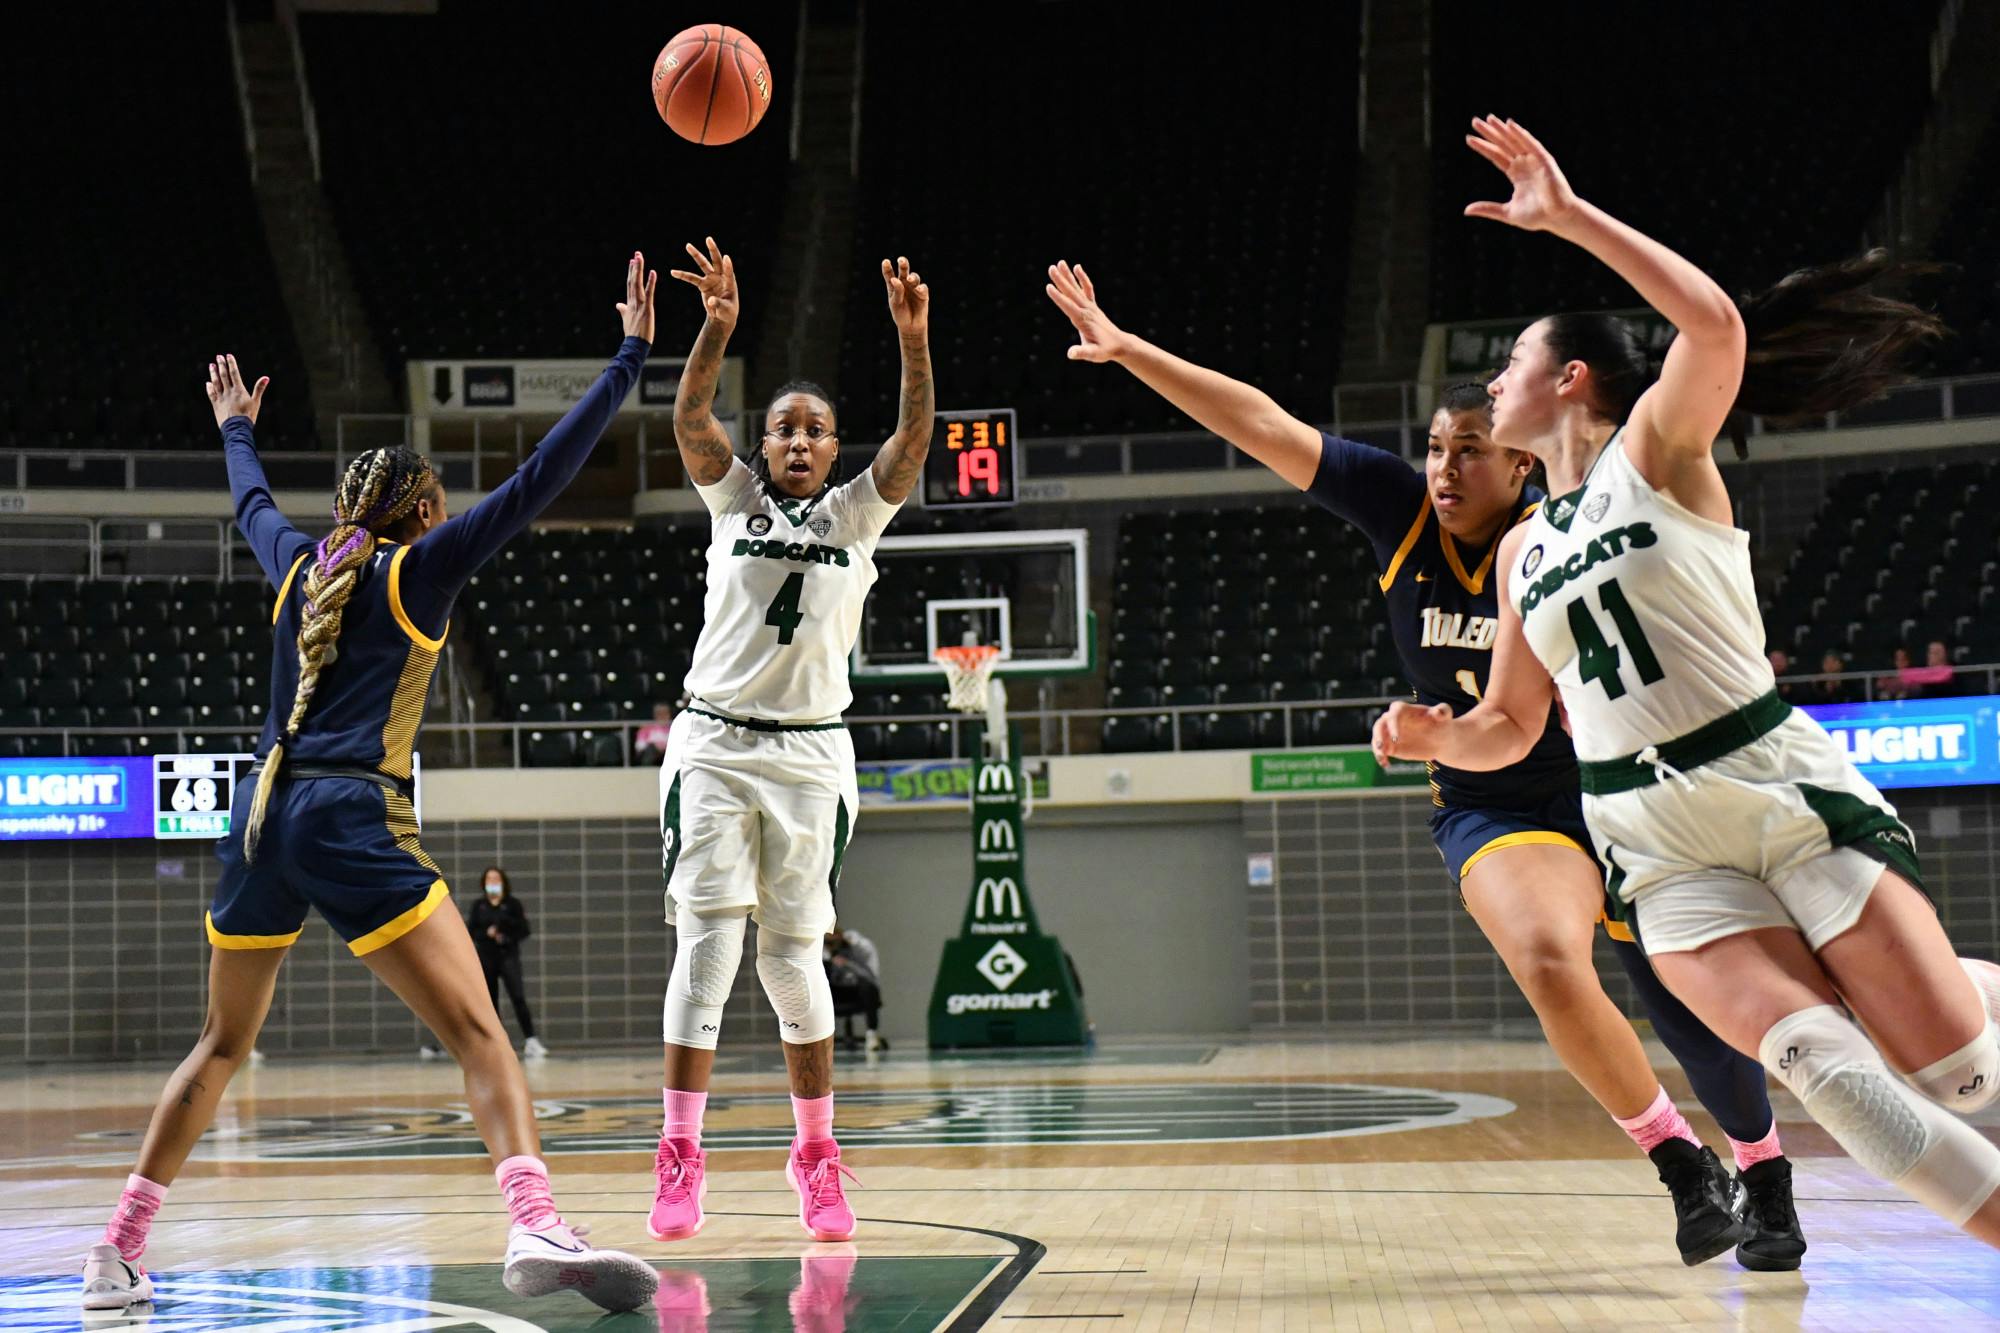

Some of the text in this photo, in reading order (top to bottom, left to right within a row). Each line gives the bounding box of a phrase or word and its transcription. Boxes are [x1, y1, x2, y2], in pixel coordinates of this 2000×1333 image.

[958, 448, 999, 497] 19
[731, 538, 850, 567] BOBCATS
[765, 572, 805, 645] 4
[1420, 607, 1498, 650] TOLED
[1567, 577, 1665, 701] 41
[1831, 724, 1965, 763] LIGHT
[7, 775, 119, 805] LIGHT
[171, 778, 218, 812] 68
[0, 815, 76, 835] sponsibly
[947, 988, 1051, 1015] gomart
